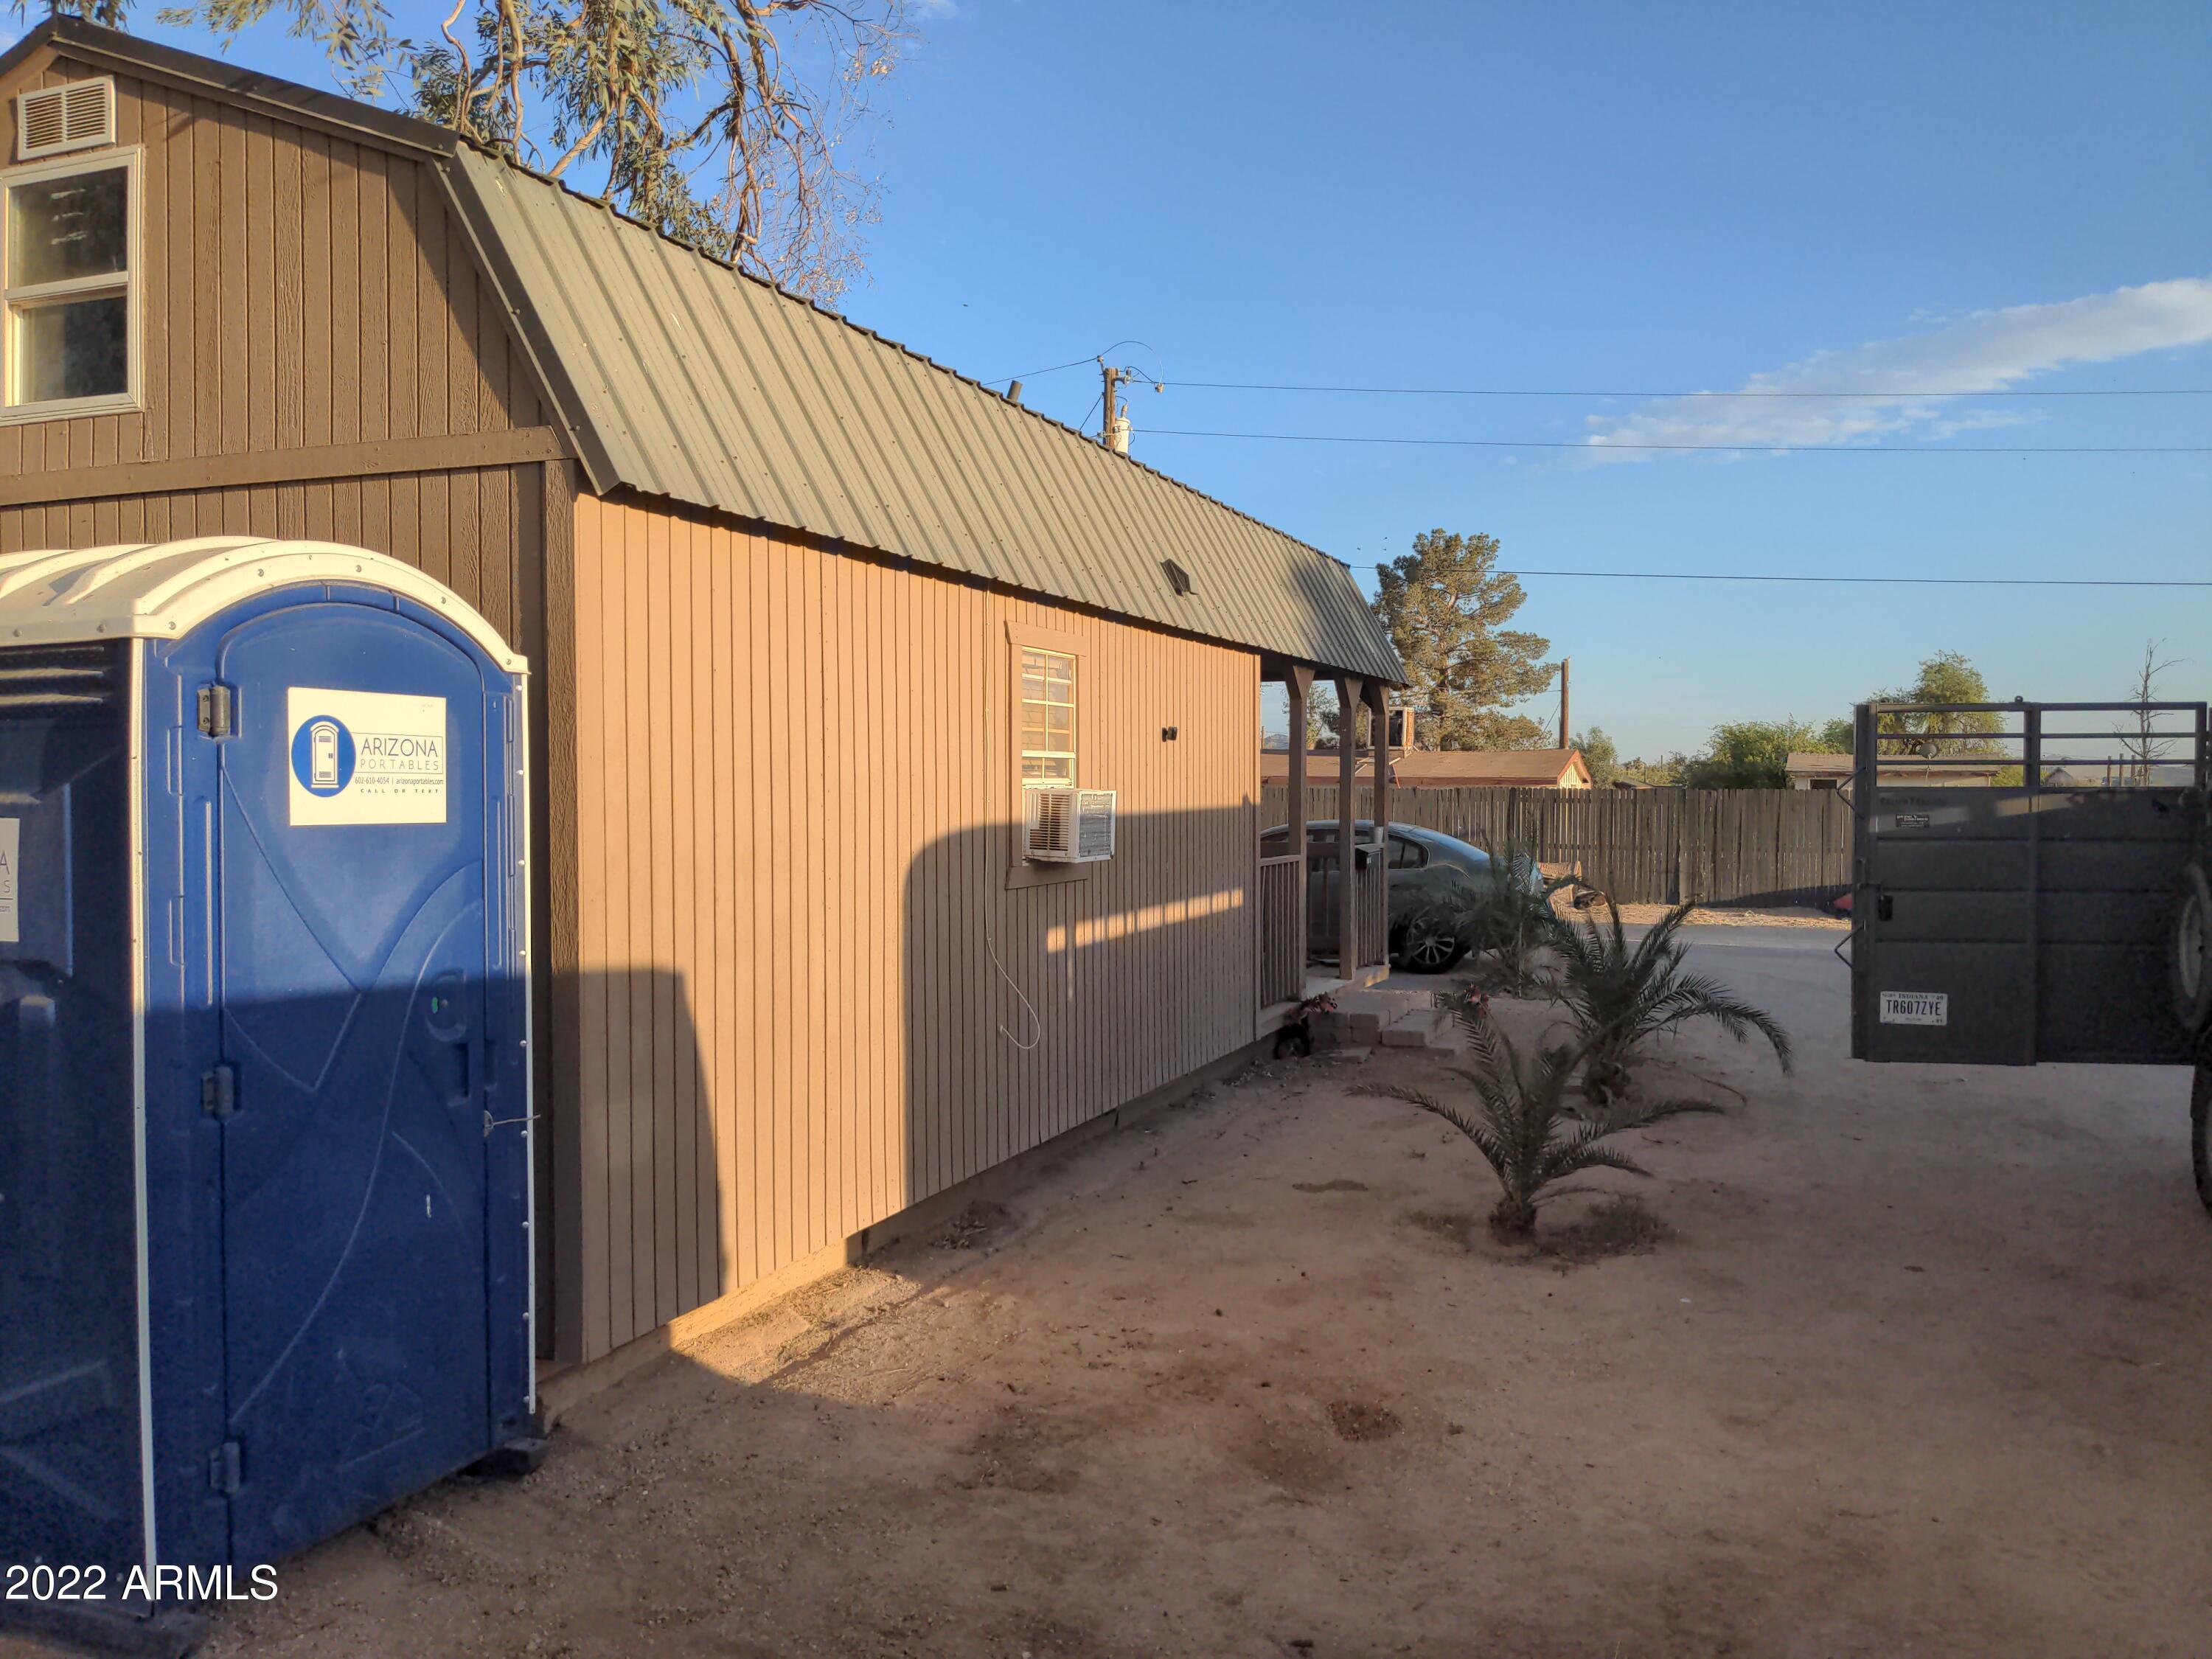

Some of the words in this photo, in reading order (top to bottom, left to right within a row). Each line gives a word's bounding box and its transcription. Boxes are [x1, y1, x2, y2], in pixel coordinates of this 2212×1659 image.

[361, 737, 438, 757] ARIZONA
[360, 759, 439, 771] PORTABLES
[355, 776, 389, 785] 602-610-4054
[396, 777, 444, 785] arizonaportables.com
[1886, 999, 1941, 1016] TR607ZYE
